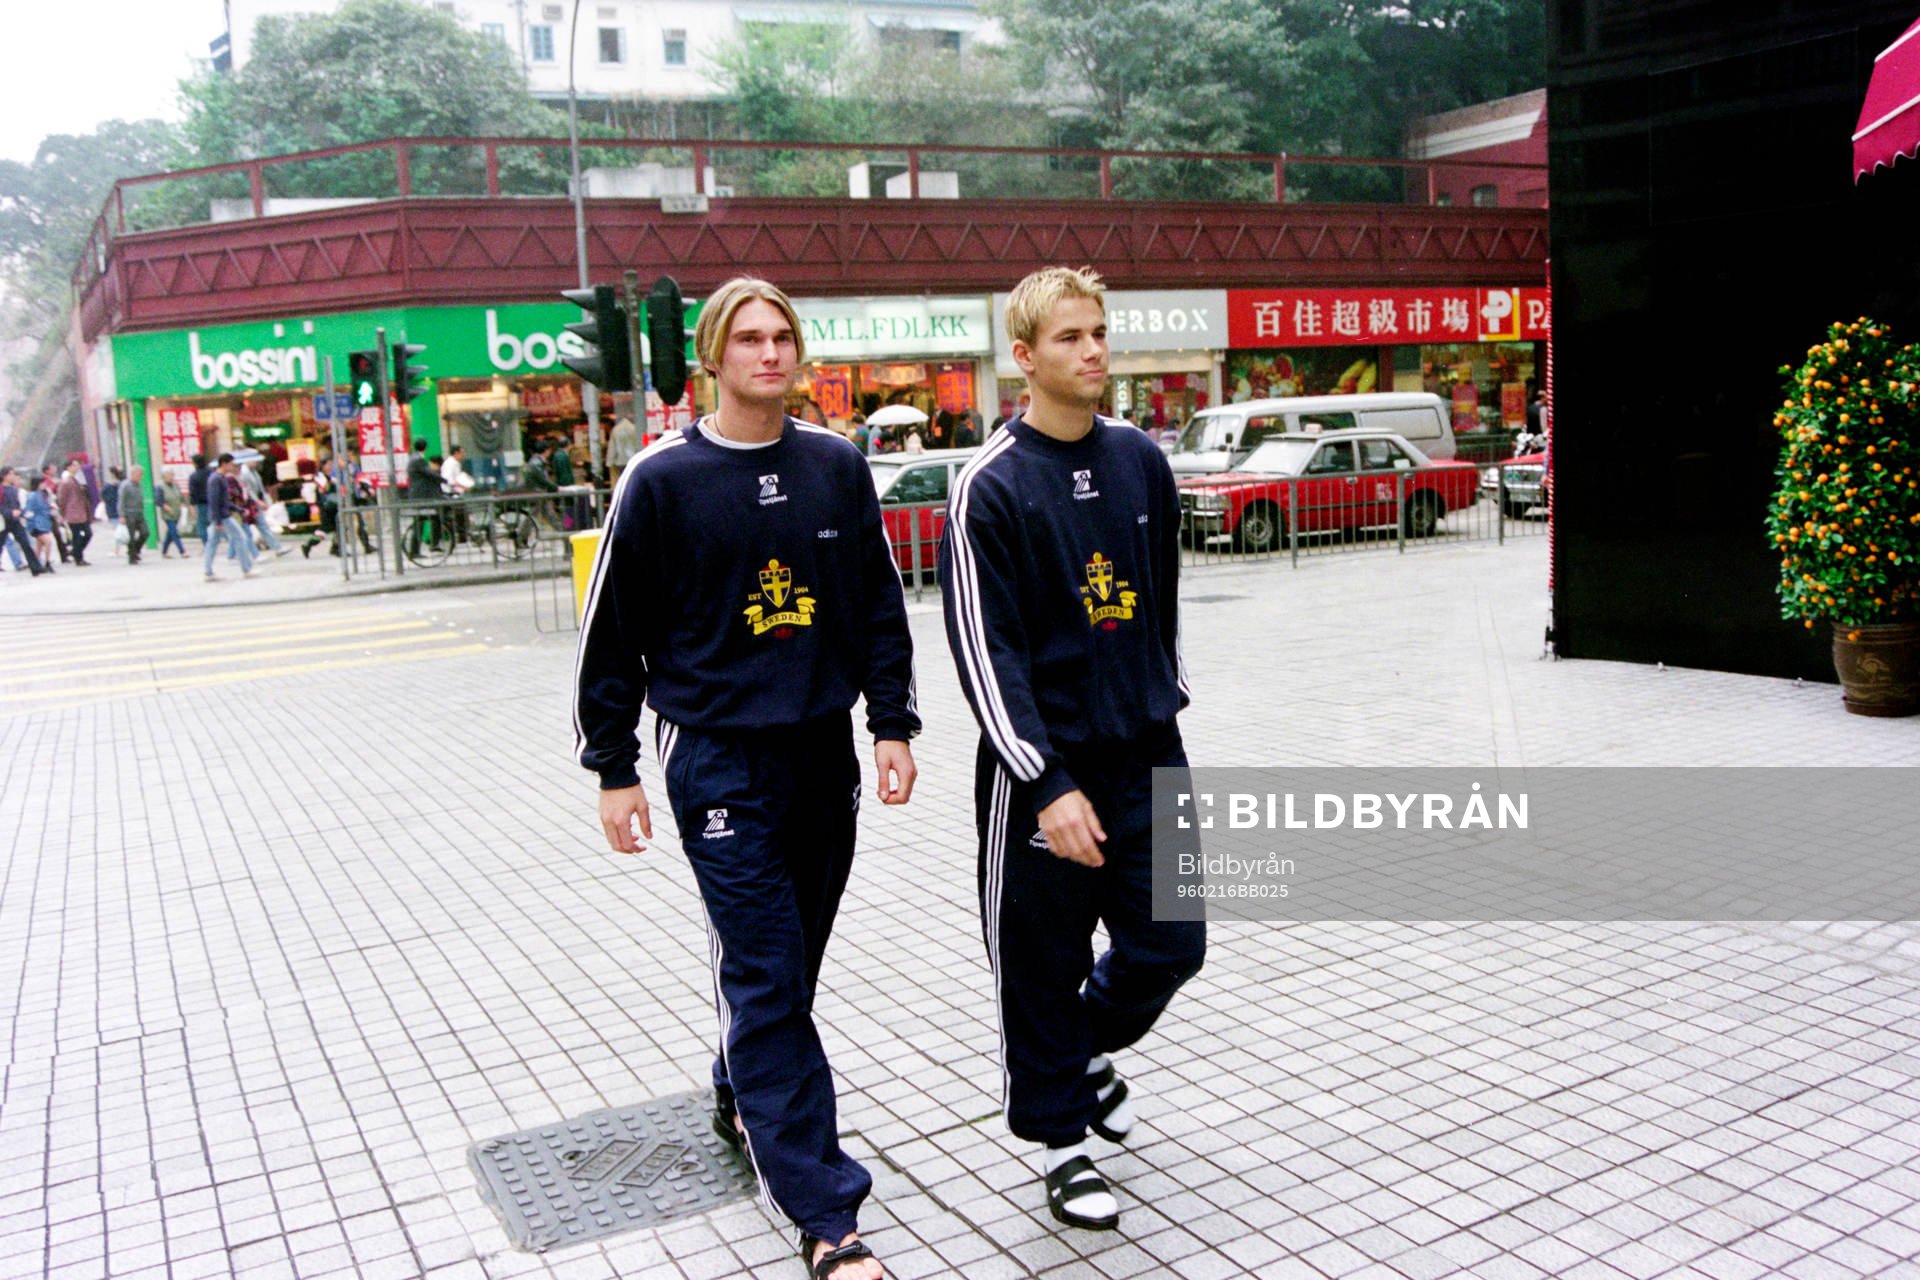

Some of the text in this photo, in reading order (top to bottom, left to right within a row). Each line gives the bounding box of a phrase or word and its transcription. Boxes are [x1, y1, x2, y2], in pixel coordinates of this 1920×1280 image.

[1253, 297, 1469, 338] 百佳超級市場
[188, 320, 318, 390] bossini
[762, 613, 802, 628] SWEDEN
